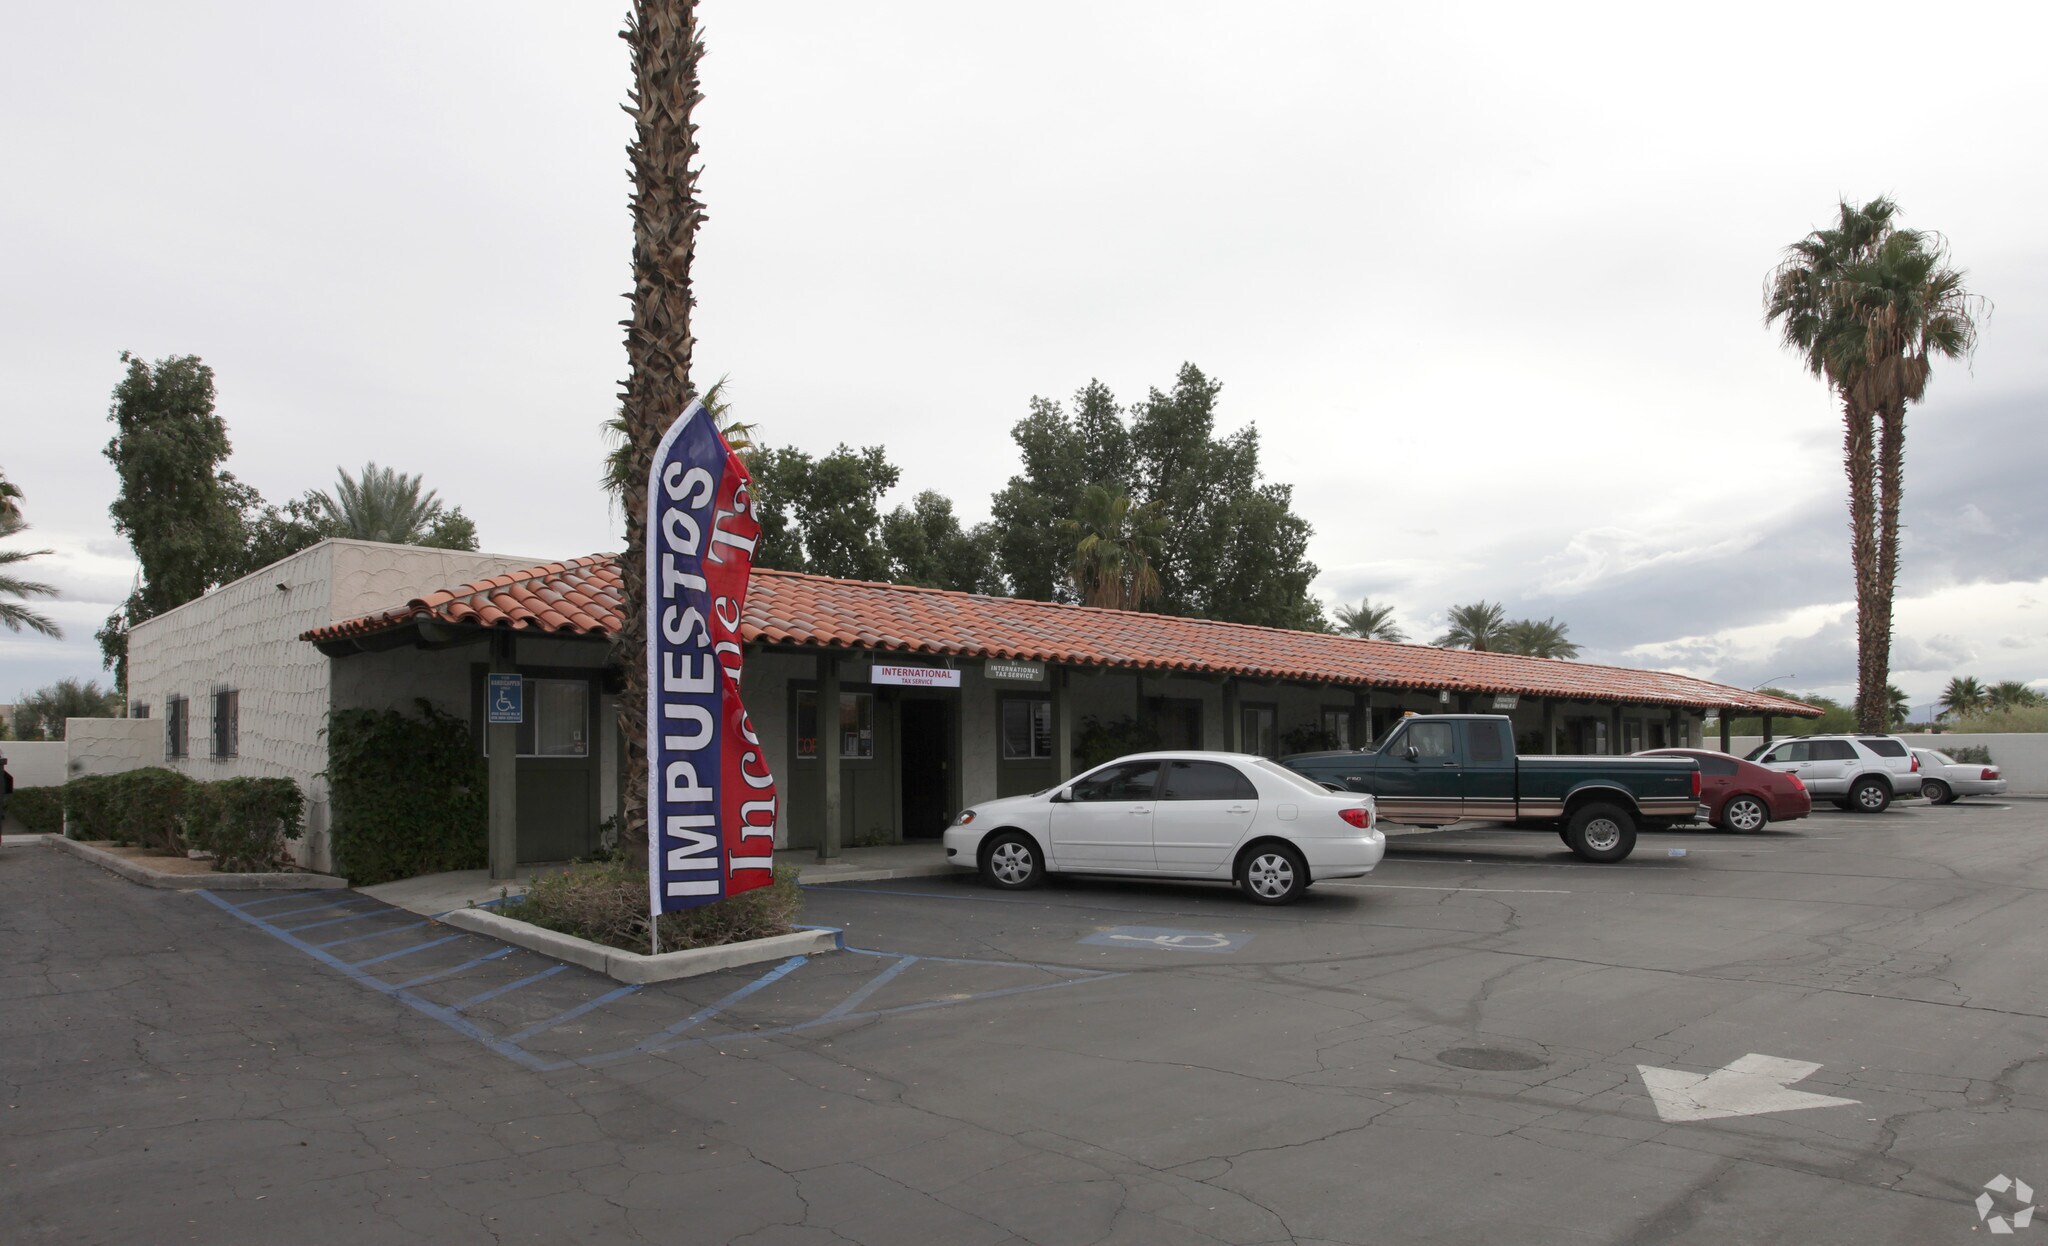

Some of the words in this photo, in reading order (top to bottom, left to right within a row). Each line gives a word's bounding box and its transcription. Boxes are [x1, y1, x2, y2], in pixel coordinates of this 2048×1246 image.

[881, 667, 952, 679] INTERNATIONAL
[990, 665, 1039, 674] INTERNATIONAL
[662, 461, 720, 897] IMPUESTOS
[912, 678, 933, 686] SERVICE
